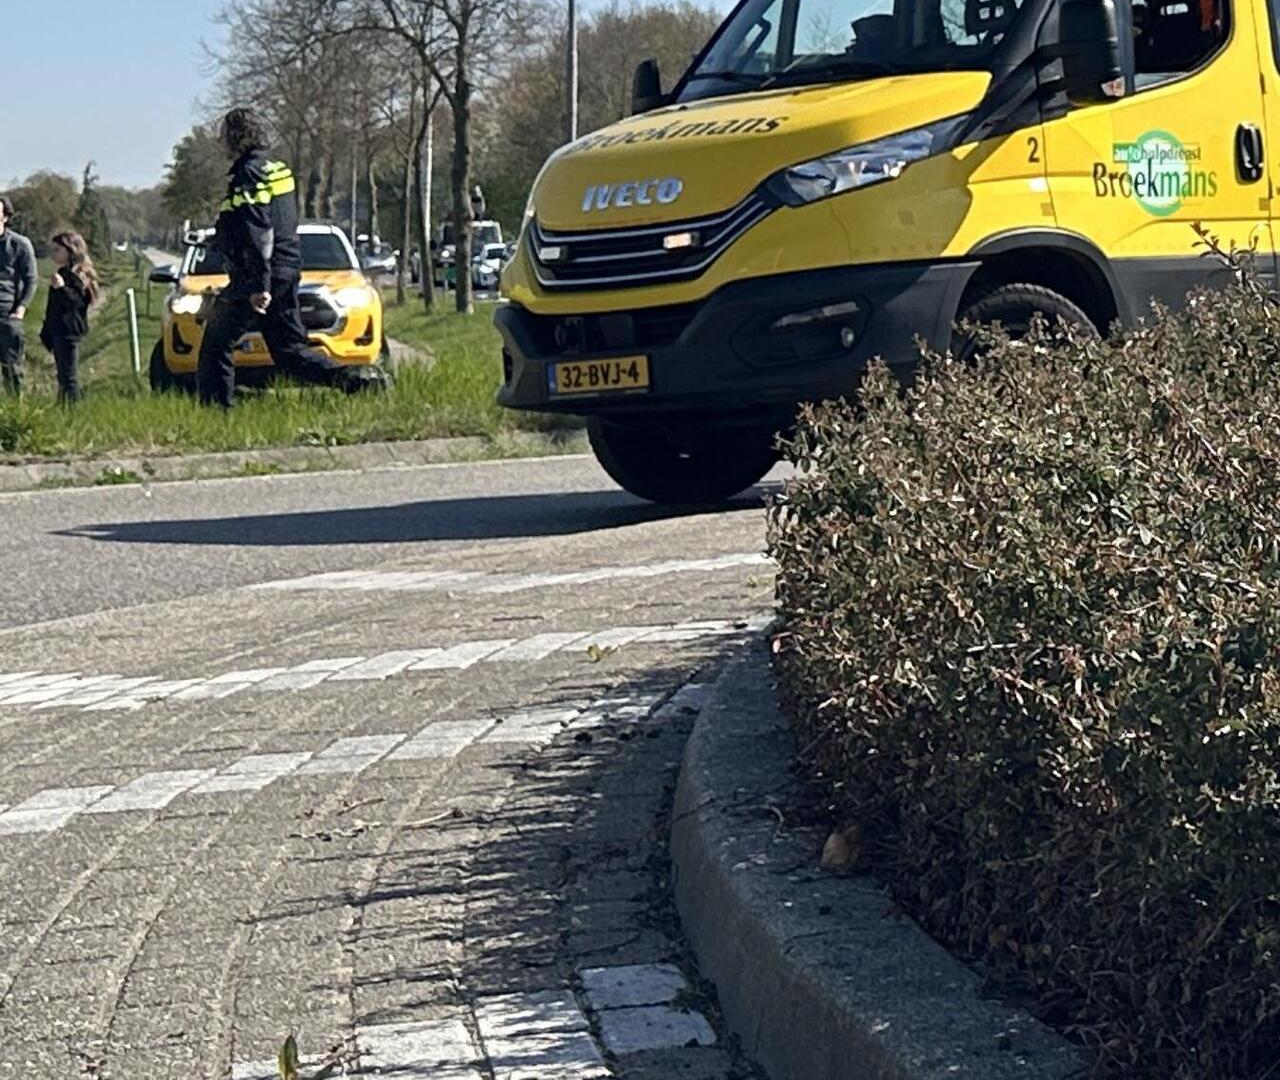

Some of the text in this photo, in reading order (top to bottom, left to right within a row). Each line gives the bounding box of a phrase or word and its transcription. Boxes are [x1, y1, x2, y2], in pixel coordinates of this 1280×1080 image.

[1027, 136, 1040, 164] 2
[1093, 158, 1218, 198] Broekmans
[581, 176, 684, 213] IVECO
[562, 360, 640, 388] 32-BVJ-4
